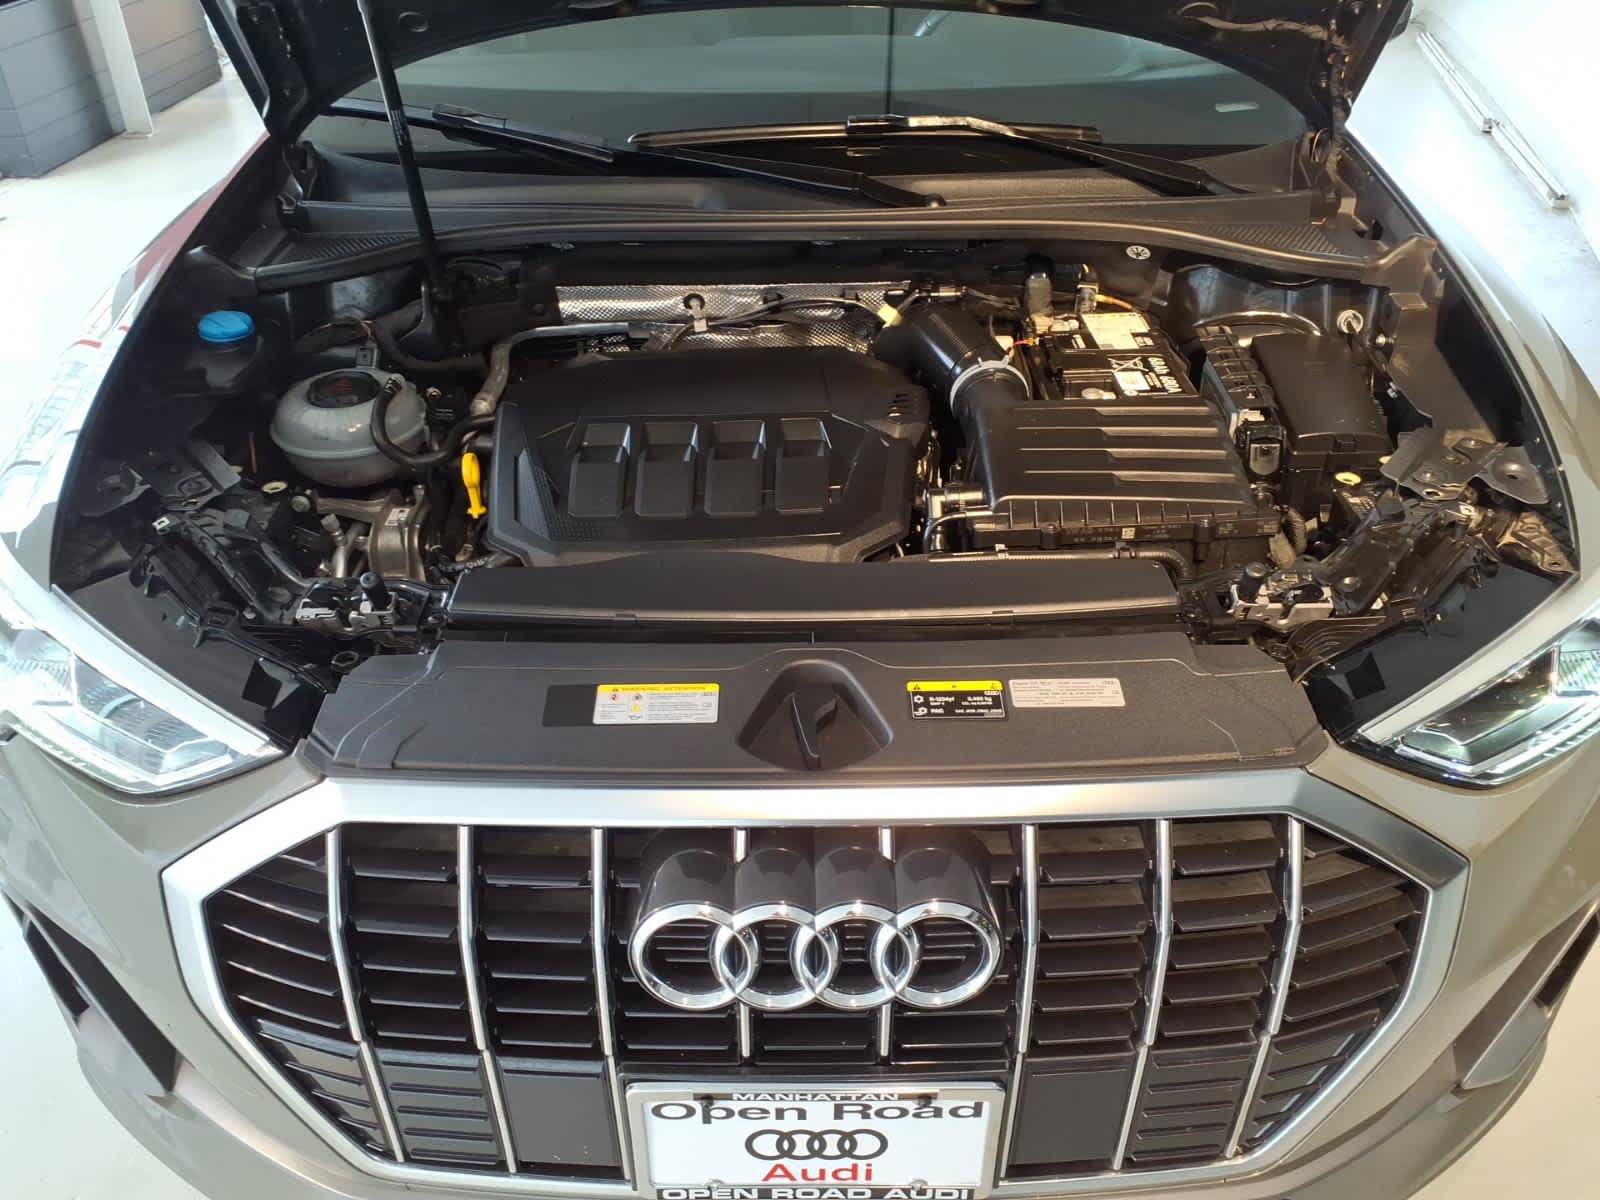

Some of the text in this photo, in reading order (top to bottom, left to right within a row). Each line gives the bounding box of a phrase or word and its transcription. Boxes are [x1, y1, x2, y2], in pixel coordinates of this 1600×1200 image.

[732, 1092, 899, 1101] MANHATTAN
[651, 1101, 983, 1124] Open Road
[761, 1163, 873, 1181] Audi
[662, 1188, 968, 1199] OPEN ROAD AUDI
